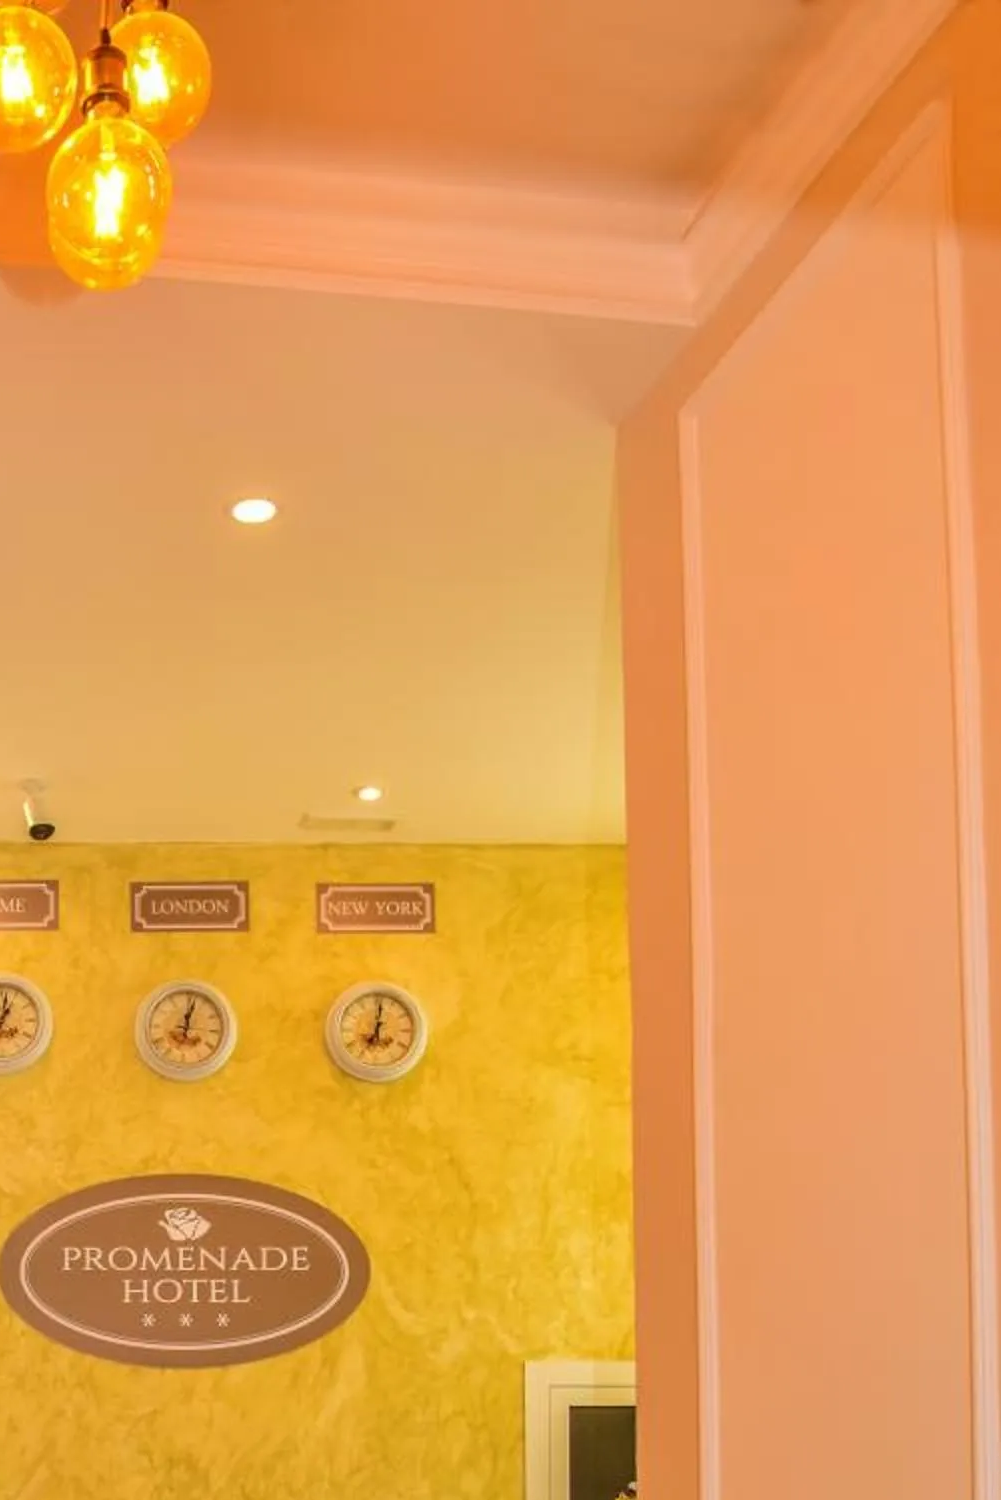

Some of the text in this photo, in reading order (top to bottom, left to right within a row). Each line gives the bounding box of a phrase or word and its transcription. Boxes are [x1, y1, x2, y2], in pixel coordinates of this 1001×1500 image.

[151, 898, 230, 915] LONDON
[327, 900, 424, 917] NEW YORK
[61, 1244, 311, 1272] PROMENADE
[122, 1278, 252, 1304] HOTEL
